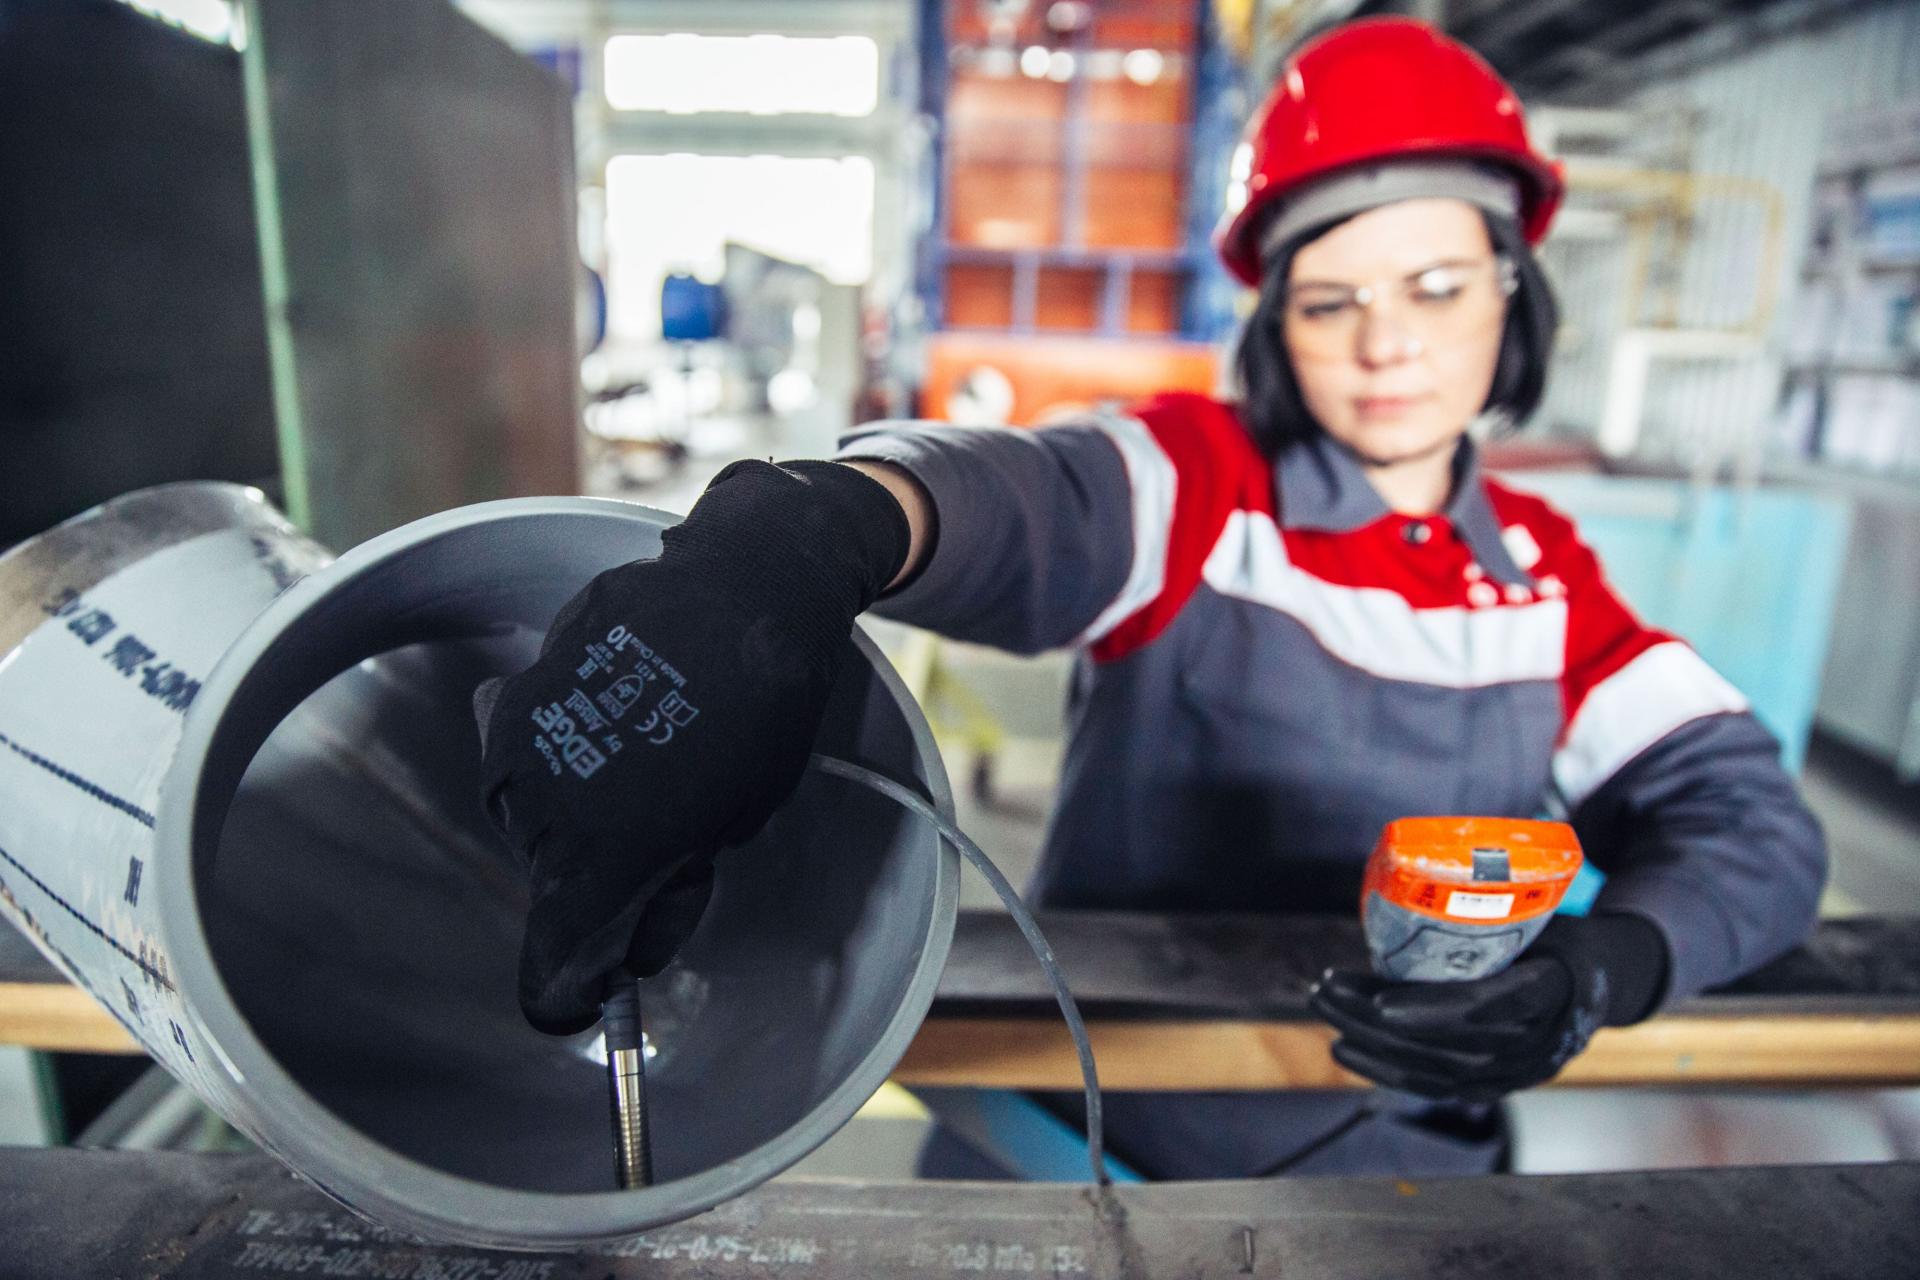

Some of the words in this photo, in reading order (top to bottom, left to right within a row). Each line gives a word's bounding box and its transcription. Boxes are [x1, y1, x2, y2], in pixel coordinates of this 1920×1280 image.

[606, 624, 632, 651] 10
[660, 662, 687, 688] Made
[564, 692, 602, 732] Ansell
[603, 734, 623, 754] by
